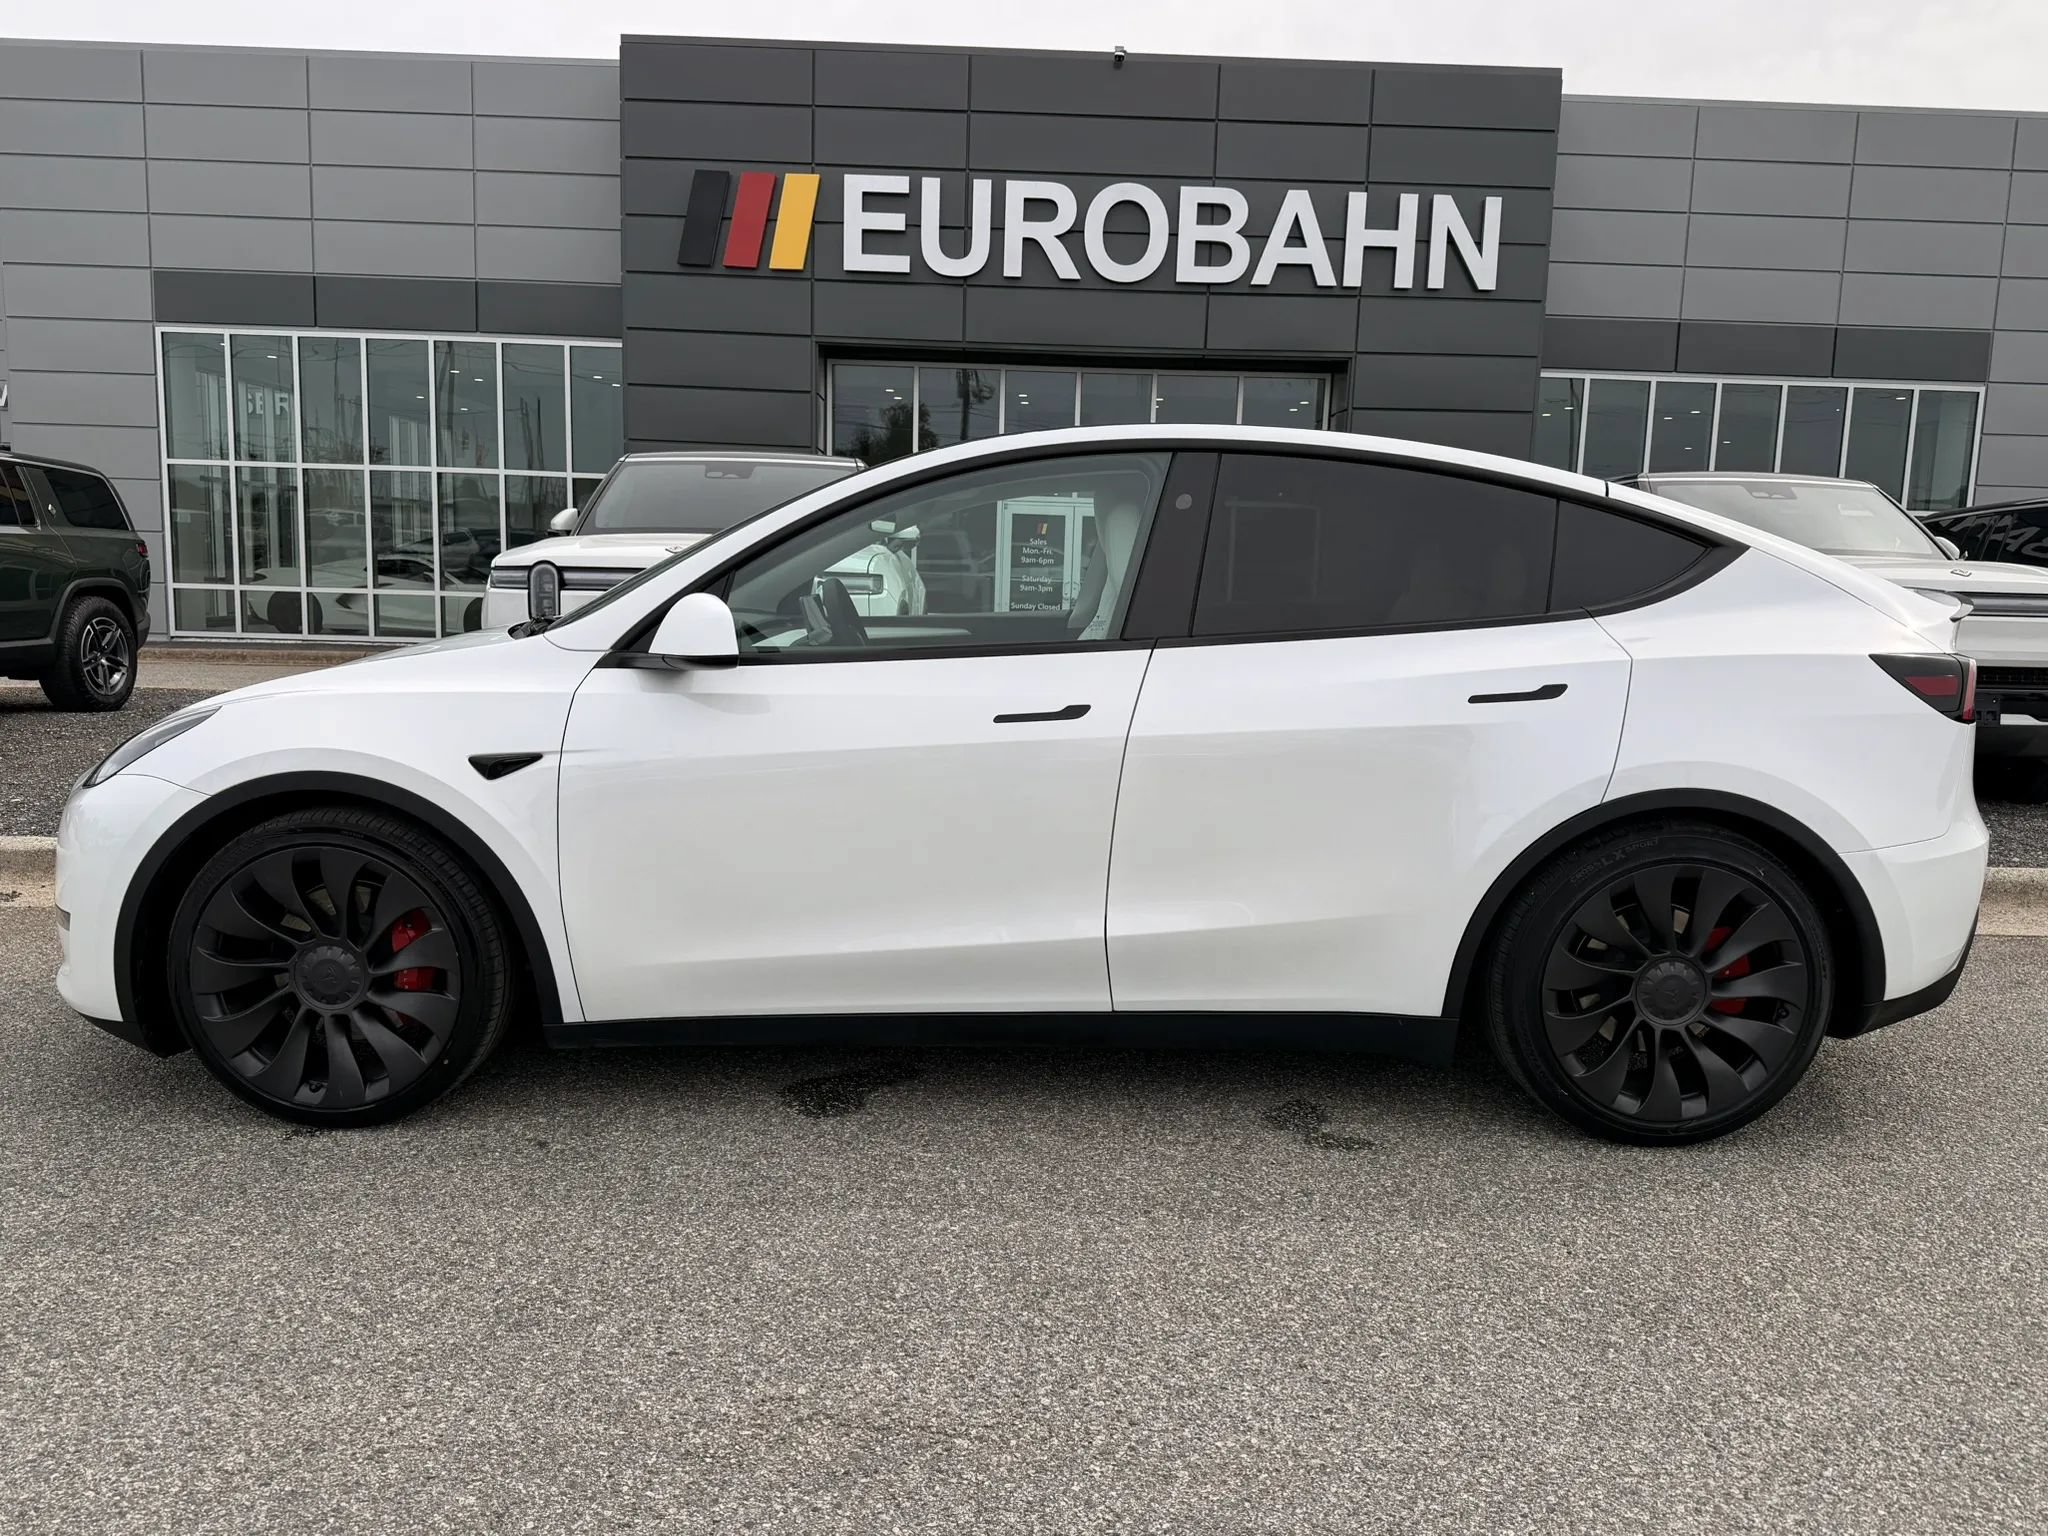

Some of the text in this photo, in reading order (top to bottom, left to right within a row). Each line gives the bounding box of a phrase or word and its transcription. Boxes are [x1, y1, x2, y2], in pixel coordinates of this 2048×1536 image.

[843, 173, 1502, 290] EUROBAHN
[1029, 538, 1047, 546] Sales
[1021, 556, 1054, 565] 9am-6pm
[1022, 575, 1052, 584] Saturday
[1020, 585, 1053, 593] 9am-3pm
[1011, 602, 1061, 612] Sunday Closed
